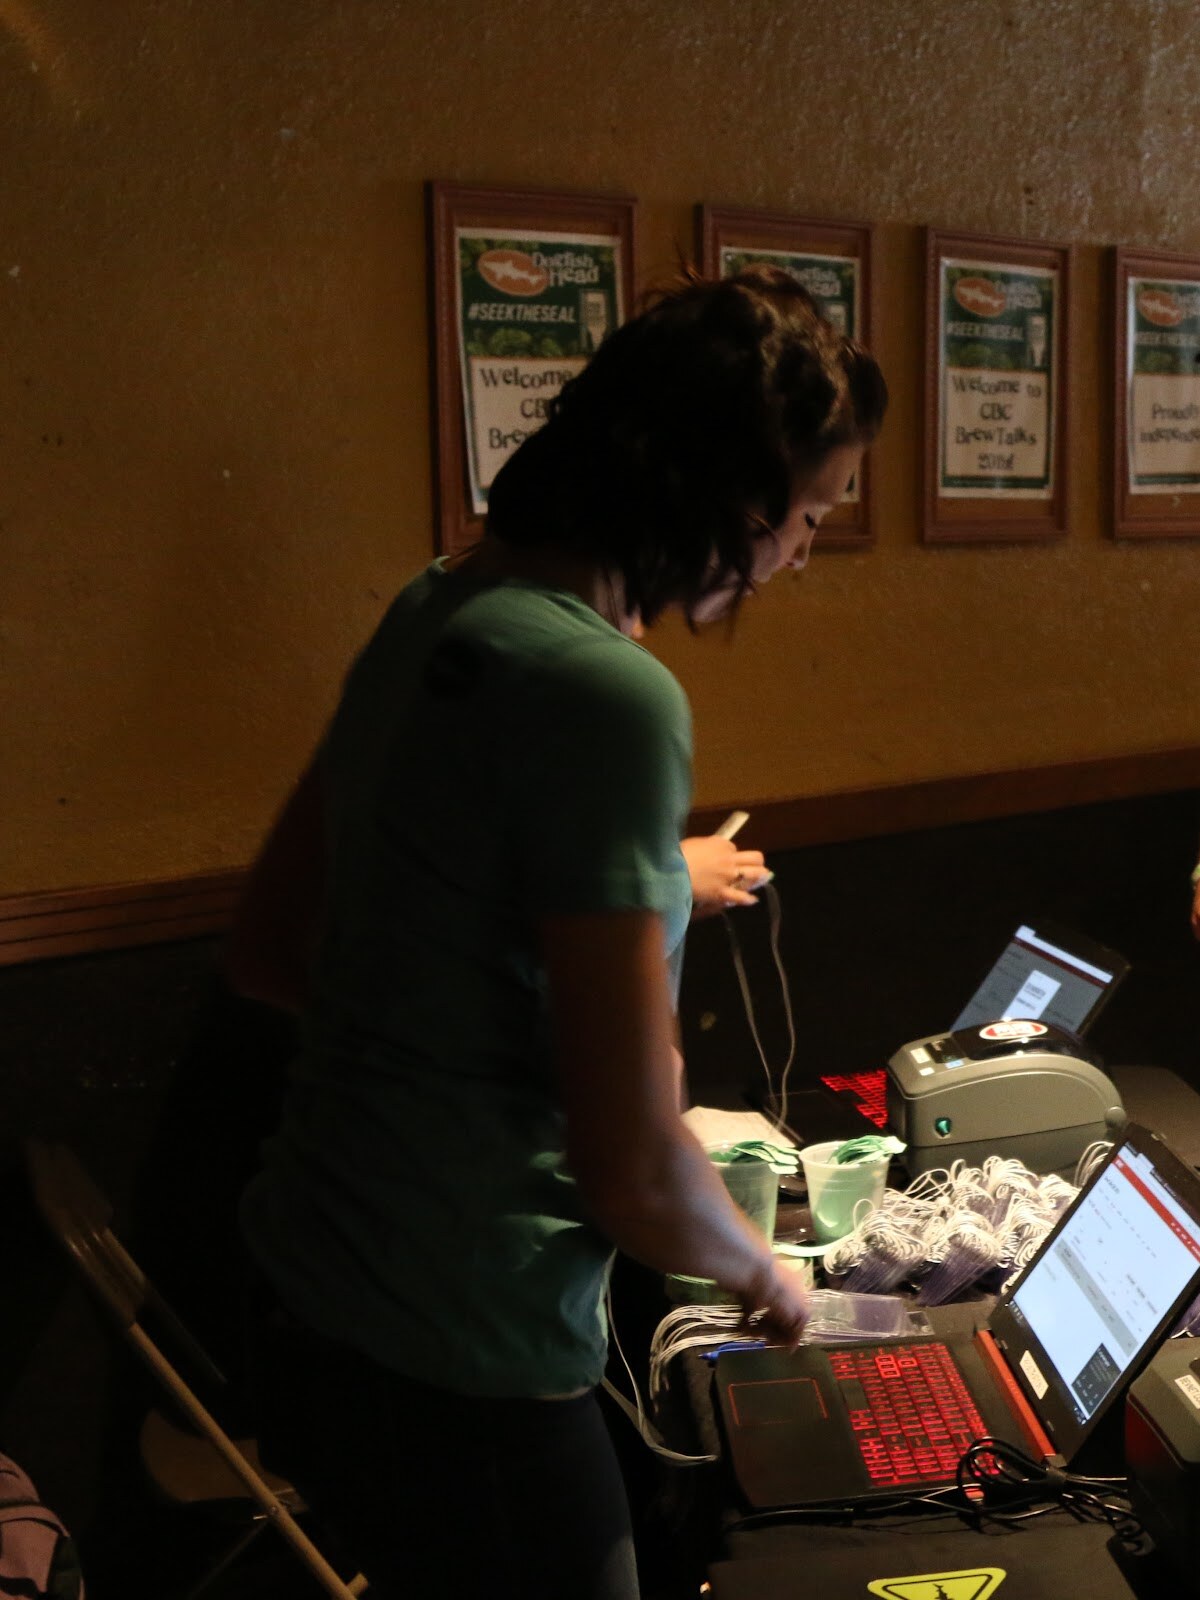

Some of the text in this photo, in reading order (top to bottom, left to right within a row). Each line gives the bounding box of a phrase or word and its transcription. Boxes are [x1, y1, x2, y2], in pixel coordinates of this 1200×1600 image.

[549, 265, 599, 288] Head
[467, 302, 577, 323] #SEEKTHESEAL
[952, 375, 1041, 398] Welcome to
[980, 402, 1013, 420] CBC
